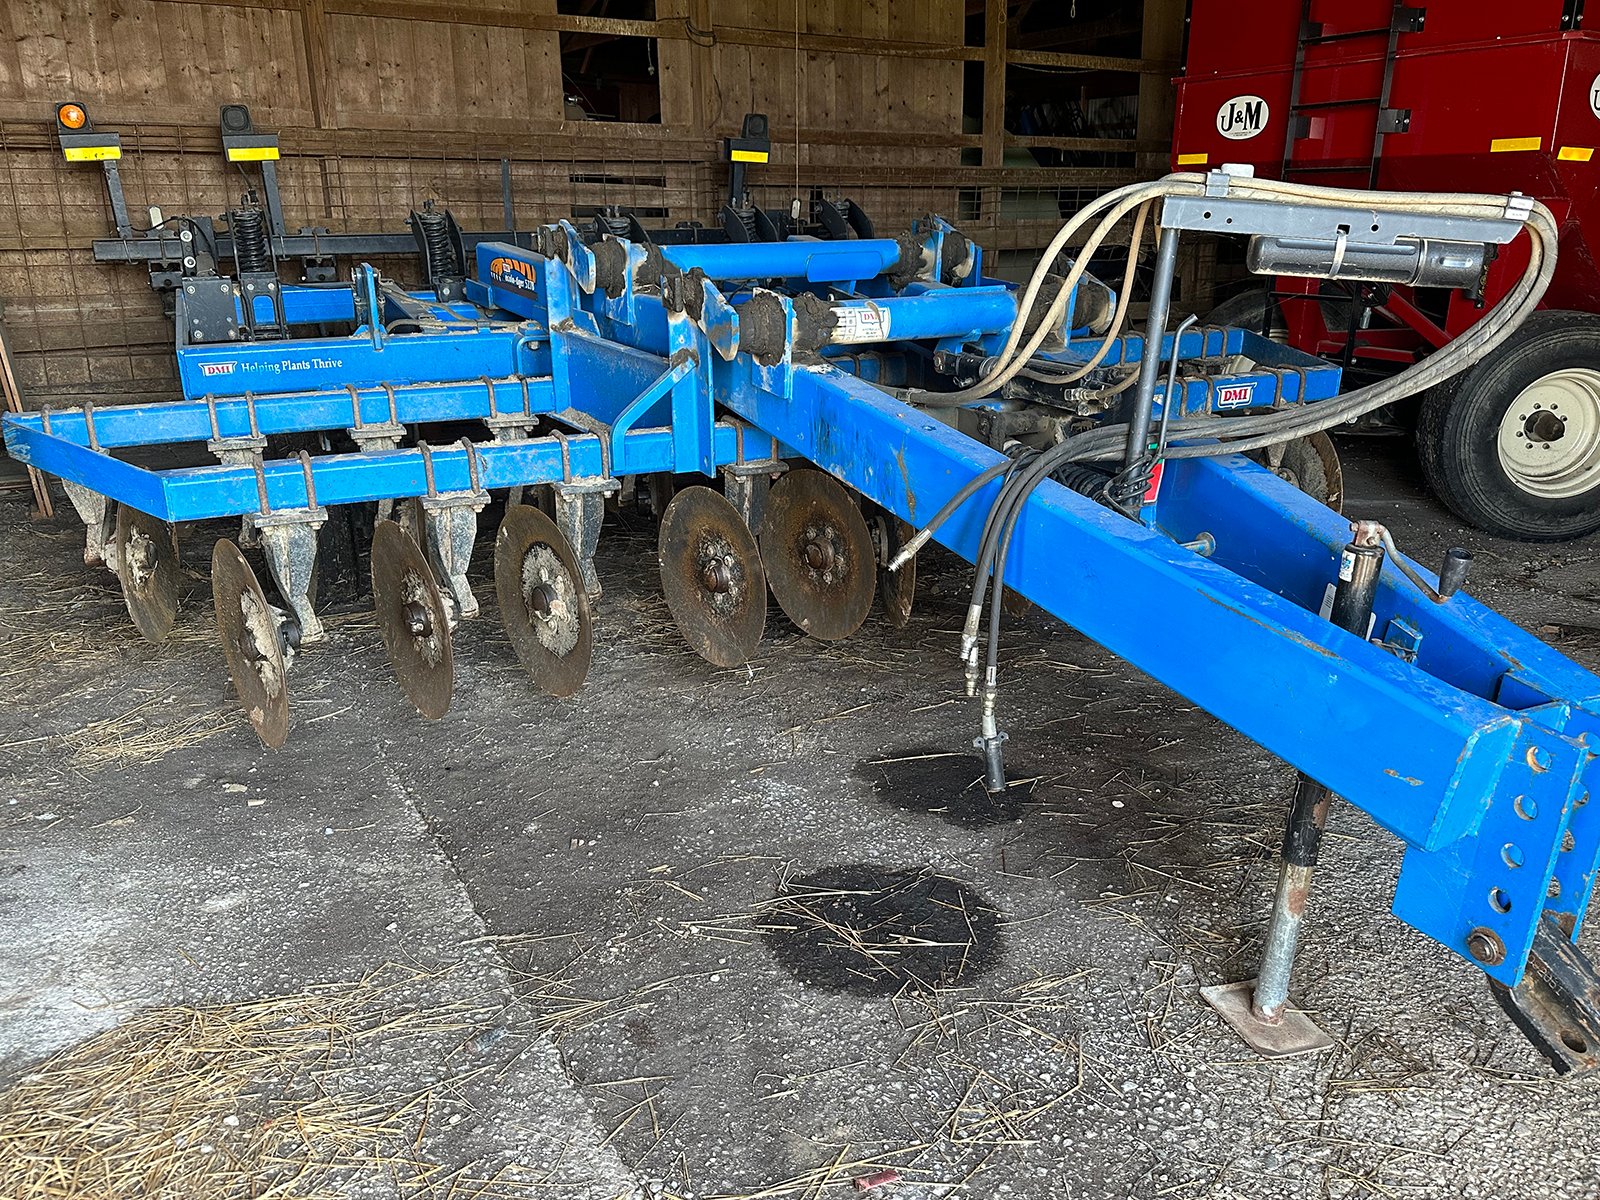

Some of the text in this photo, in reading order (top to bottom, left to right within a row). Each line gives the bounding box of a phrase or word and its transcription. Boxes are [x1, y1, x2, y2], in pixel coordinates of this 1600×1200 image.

[1220, 101, 1263, 132] J&M
[207, 365, 231, 375] DMI
[241, 357, 343, 375] Helping Plants Thrive
[1223, 388, 1248, 402] DMI
